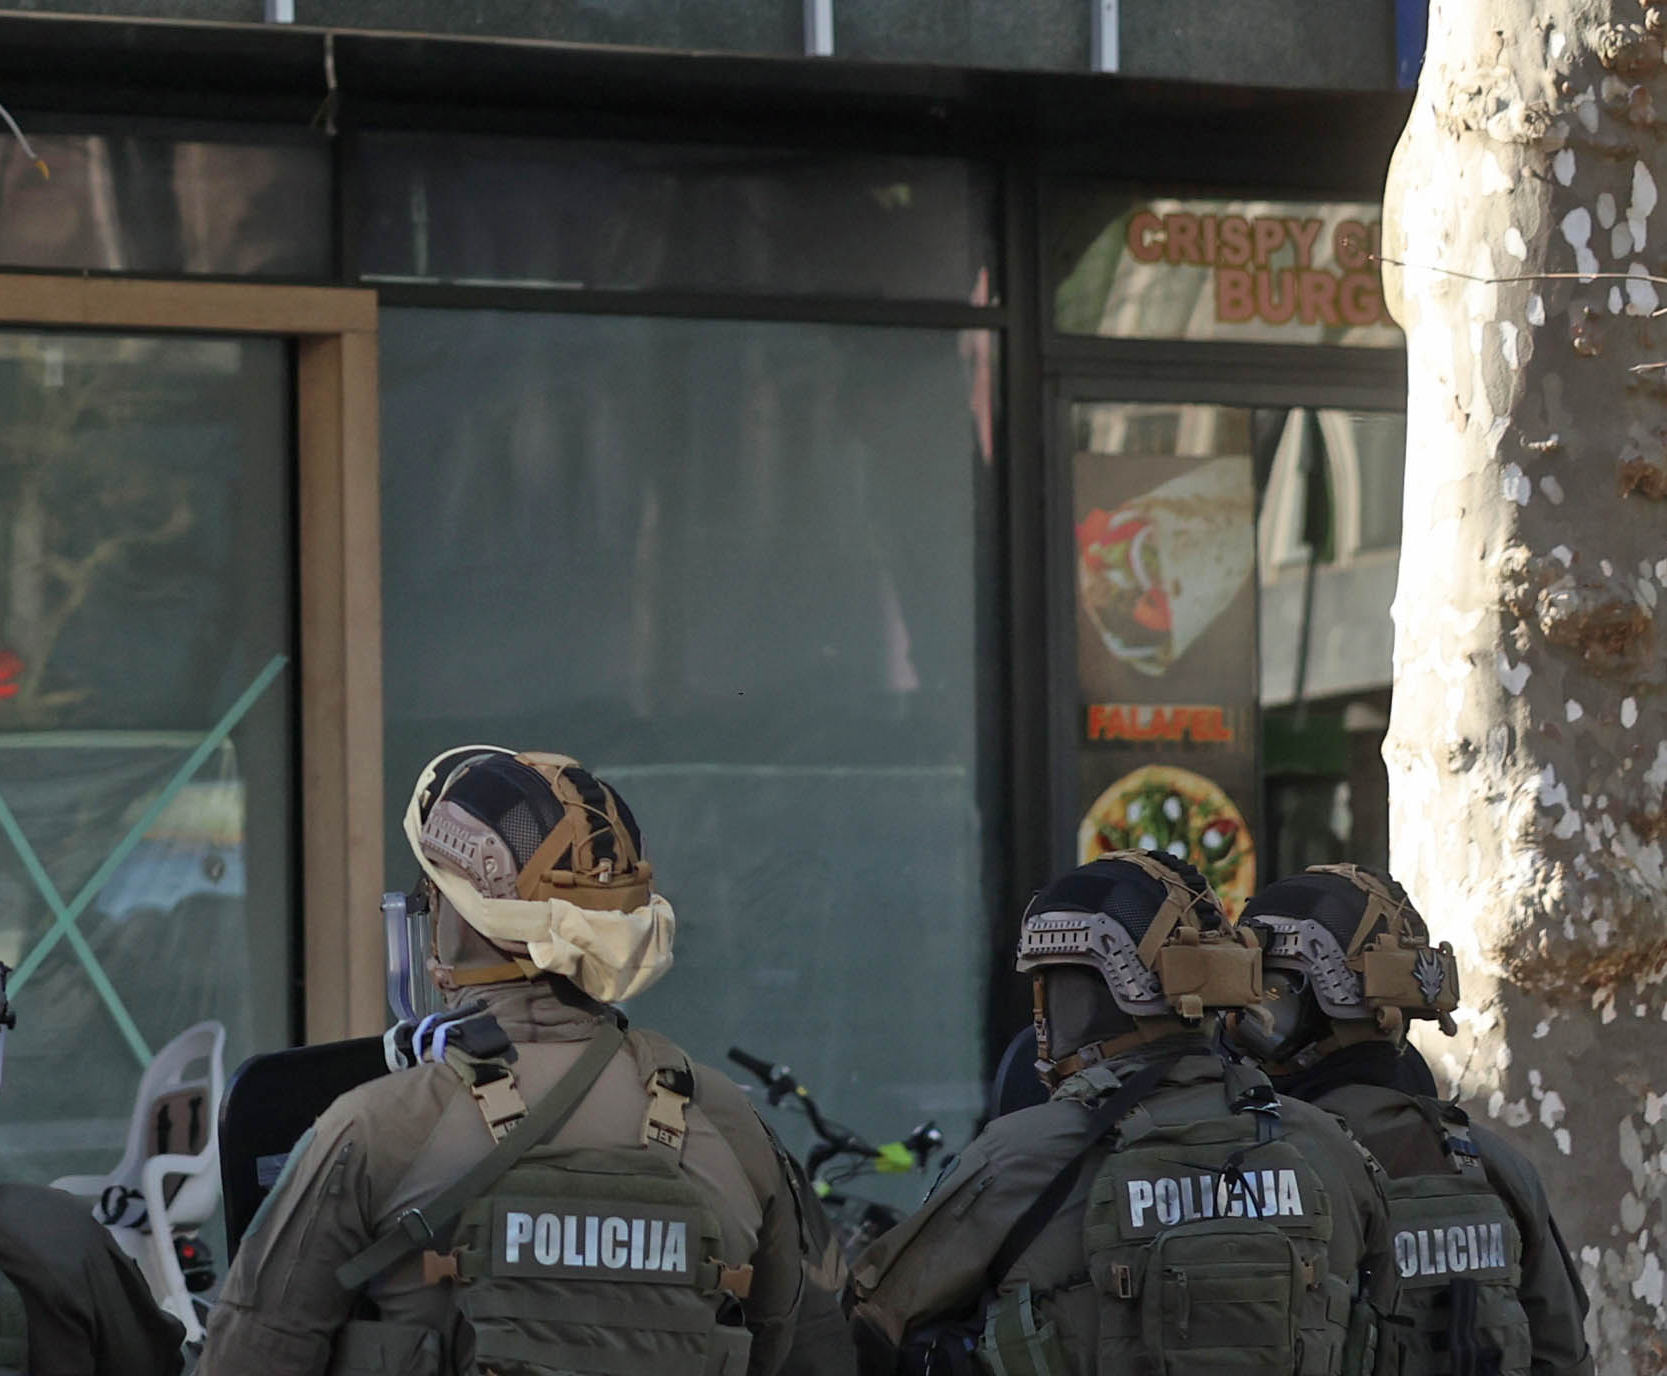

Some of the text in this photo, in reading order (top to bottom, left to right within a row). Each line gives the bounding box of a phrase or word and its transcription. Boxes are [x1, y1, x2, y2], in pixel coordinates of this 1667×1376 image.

[1126, 210, 1322, 268] CRISPY
[1215, 266, 1397, 328] BURG
[1089, 704, 1233, 742] FALAFEL
[1127, 1169, 1304, 1228] POLICIJA
[505, 1212, 687, 1272] POLICIJA
[1394, 1223, 1506, 1278] OLICIJA
